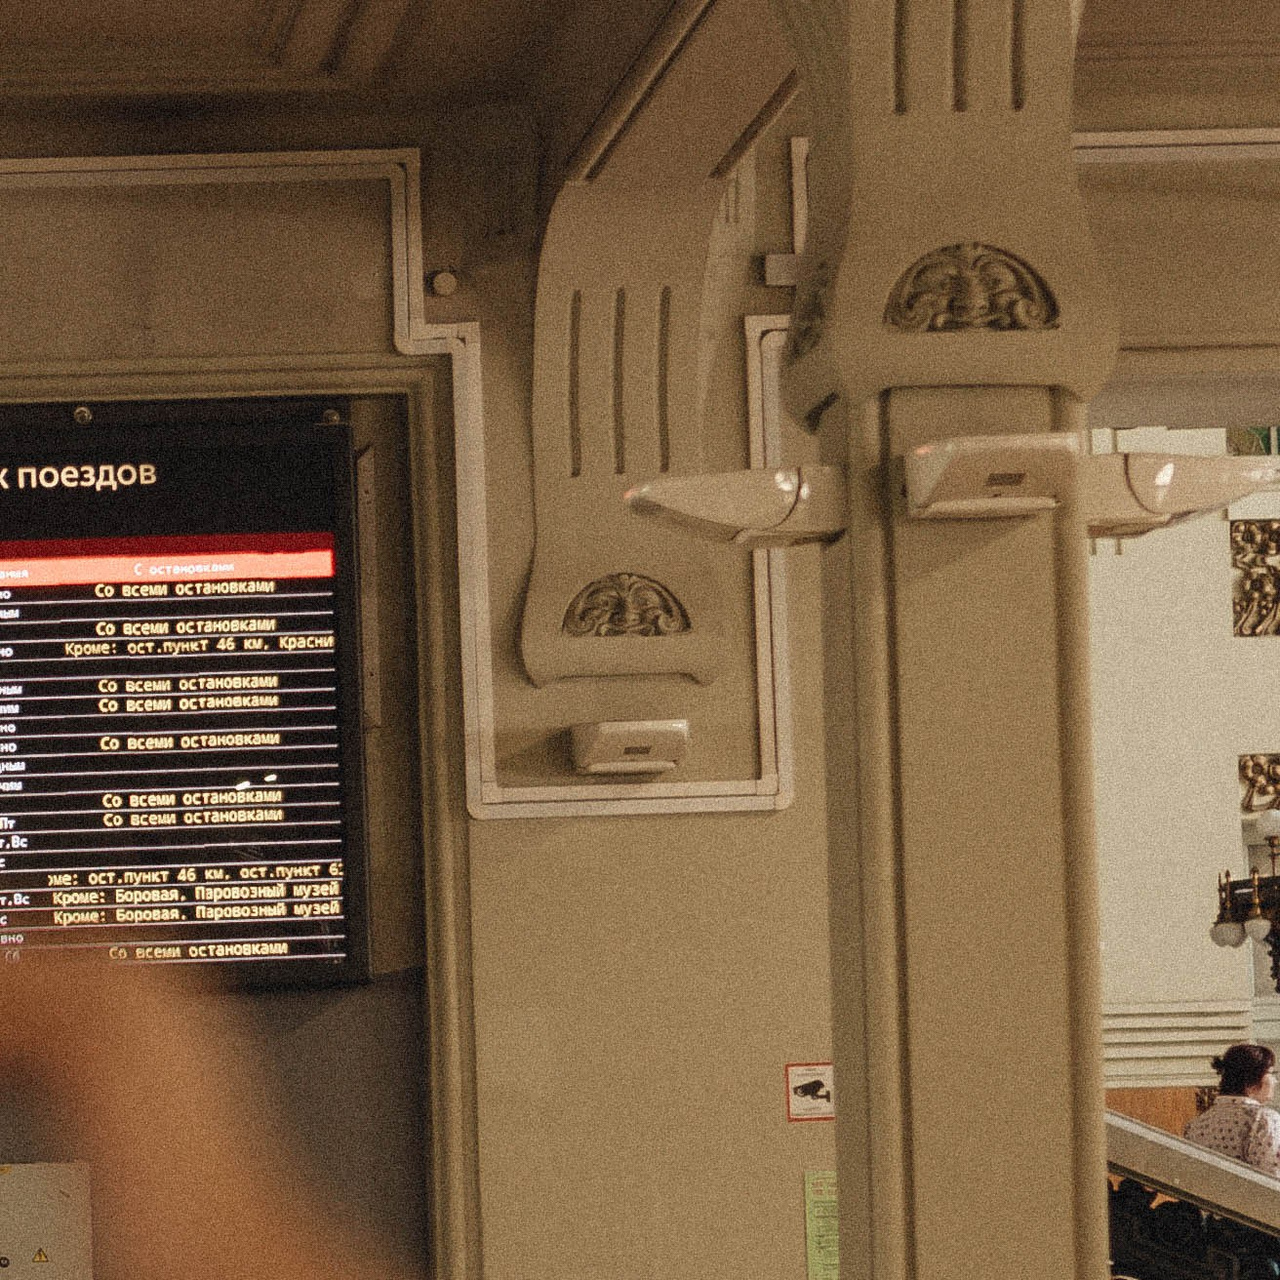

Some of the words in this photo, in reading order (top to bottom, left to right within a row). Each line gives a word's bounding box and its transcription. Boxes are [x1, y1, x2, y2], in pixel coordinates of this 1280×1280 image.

[17, 463, 157, 492] поездов
[94, 583, 114, 597] Со
[122, 583, 168, 596] всеми
[175, 580, 275, 595] остановками
[95, 621, 115, 635] Со
[123, 621, 169, 634] всеми
[176, 618, 276, 633] остановками
[65, 640, 116, 657] Кроме:
[127, 639, 209, 655] ост.пункт
[216, 636, 235, 650] 46
[98, 678, 118, 692] Со
[126, 679, 171, 692] всеми
[179, 675, 278, 690] остановками
[102, 793, 122, 807] Со
[129, 793, 176, 806] всеми
[182, 789, 282, 804] остановками
[0, 815, 16, 829] Пт
[103, 812, 123, 826] Со
[130, 812, 176, 825] всеми
[183, 808, 284, 823] остановками
[88, 869, 169, 886] ост.пункт
[177, 866, 196, 881] 46
[239, 864, 321, 880] ост.пункт
[53, 889, 105, 906] Кроме:
[195, 882, 286, 901] Паровозный
[293, 881, 339, 898] музей
[54, 908, 105, 925] Кроме:
[196, 901, 287, 920] Паровозный
[293, 900, 340, 917] музей
[189, 942, 288, 956] остановками
